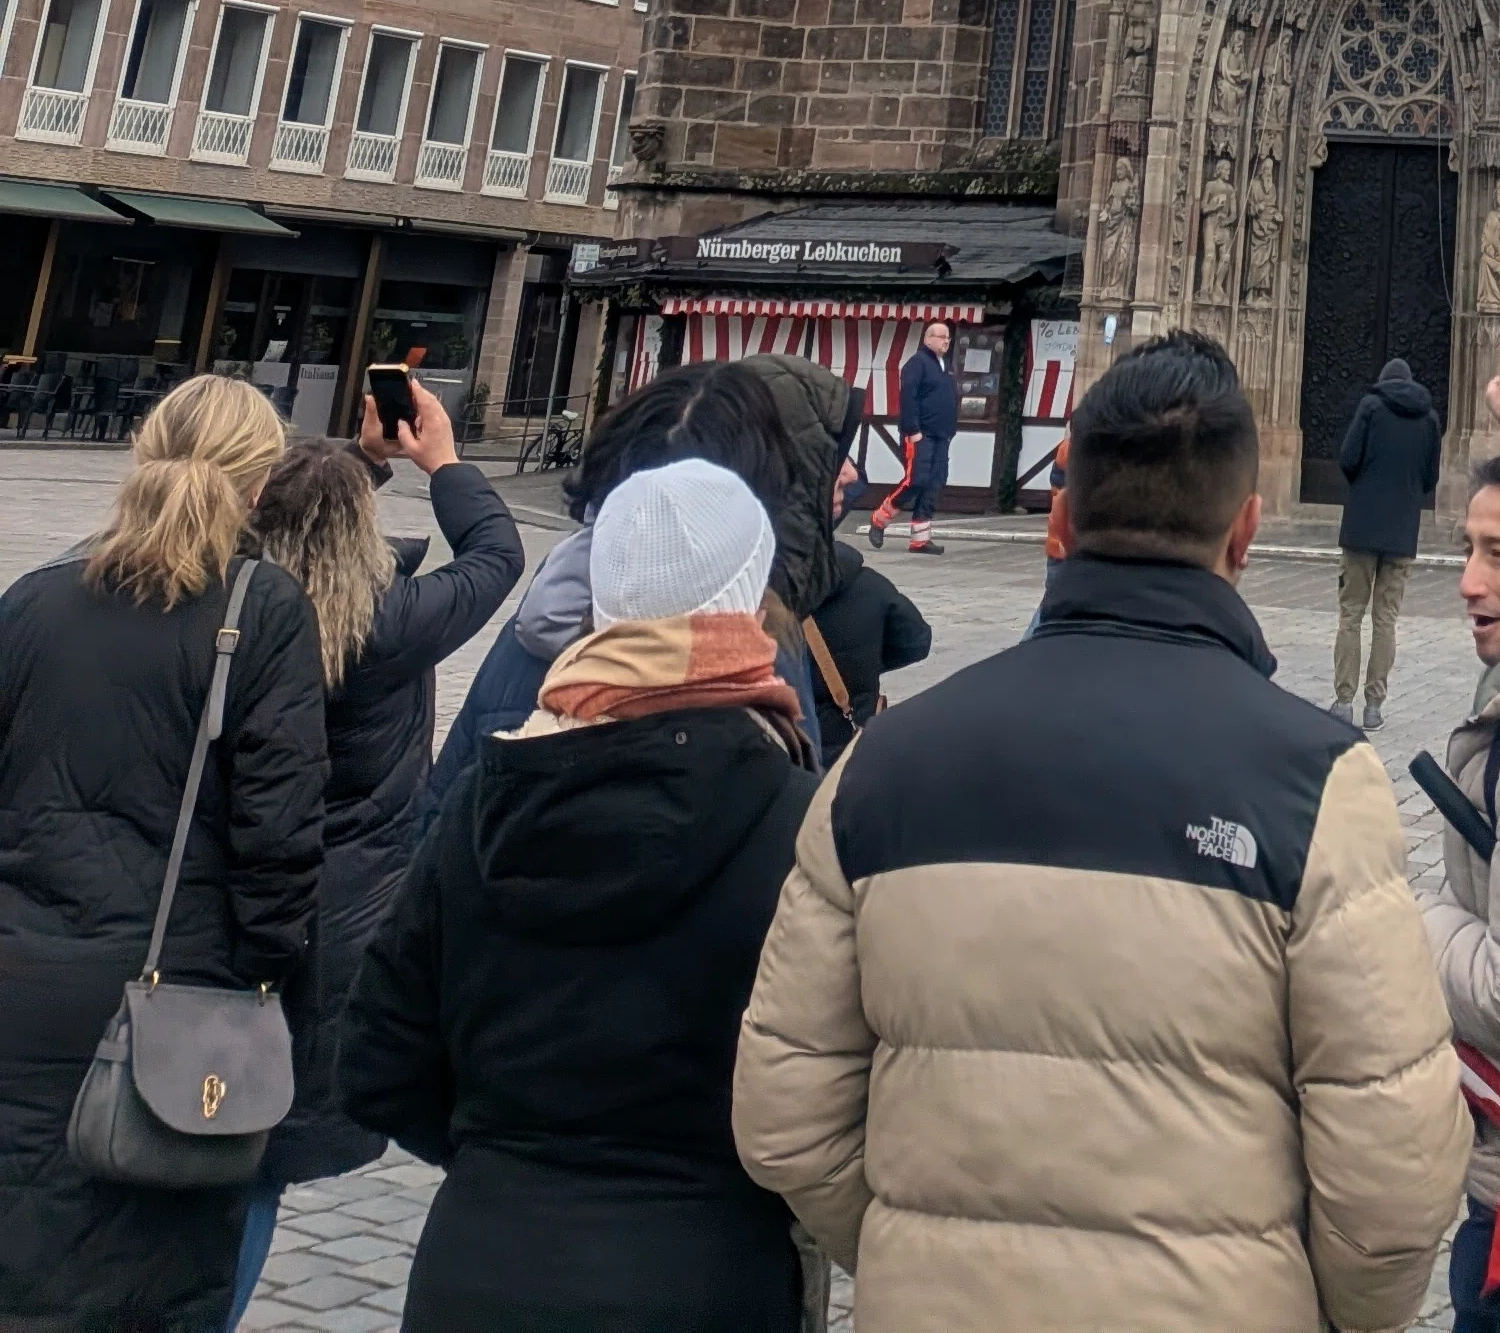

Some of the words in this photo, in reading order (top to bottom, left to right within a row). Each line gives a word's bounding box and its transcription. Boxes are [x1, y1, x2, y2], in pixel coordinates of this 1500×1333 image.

[697, 237, 800, 265] Nürnberger
[802, 241, 902, 263] Lebkuchen
[1186, 823, 1234, 849] NORTH
[1211, 816, 1236, 836] THE
[1198, 841, 1232, 862] FACE
